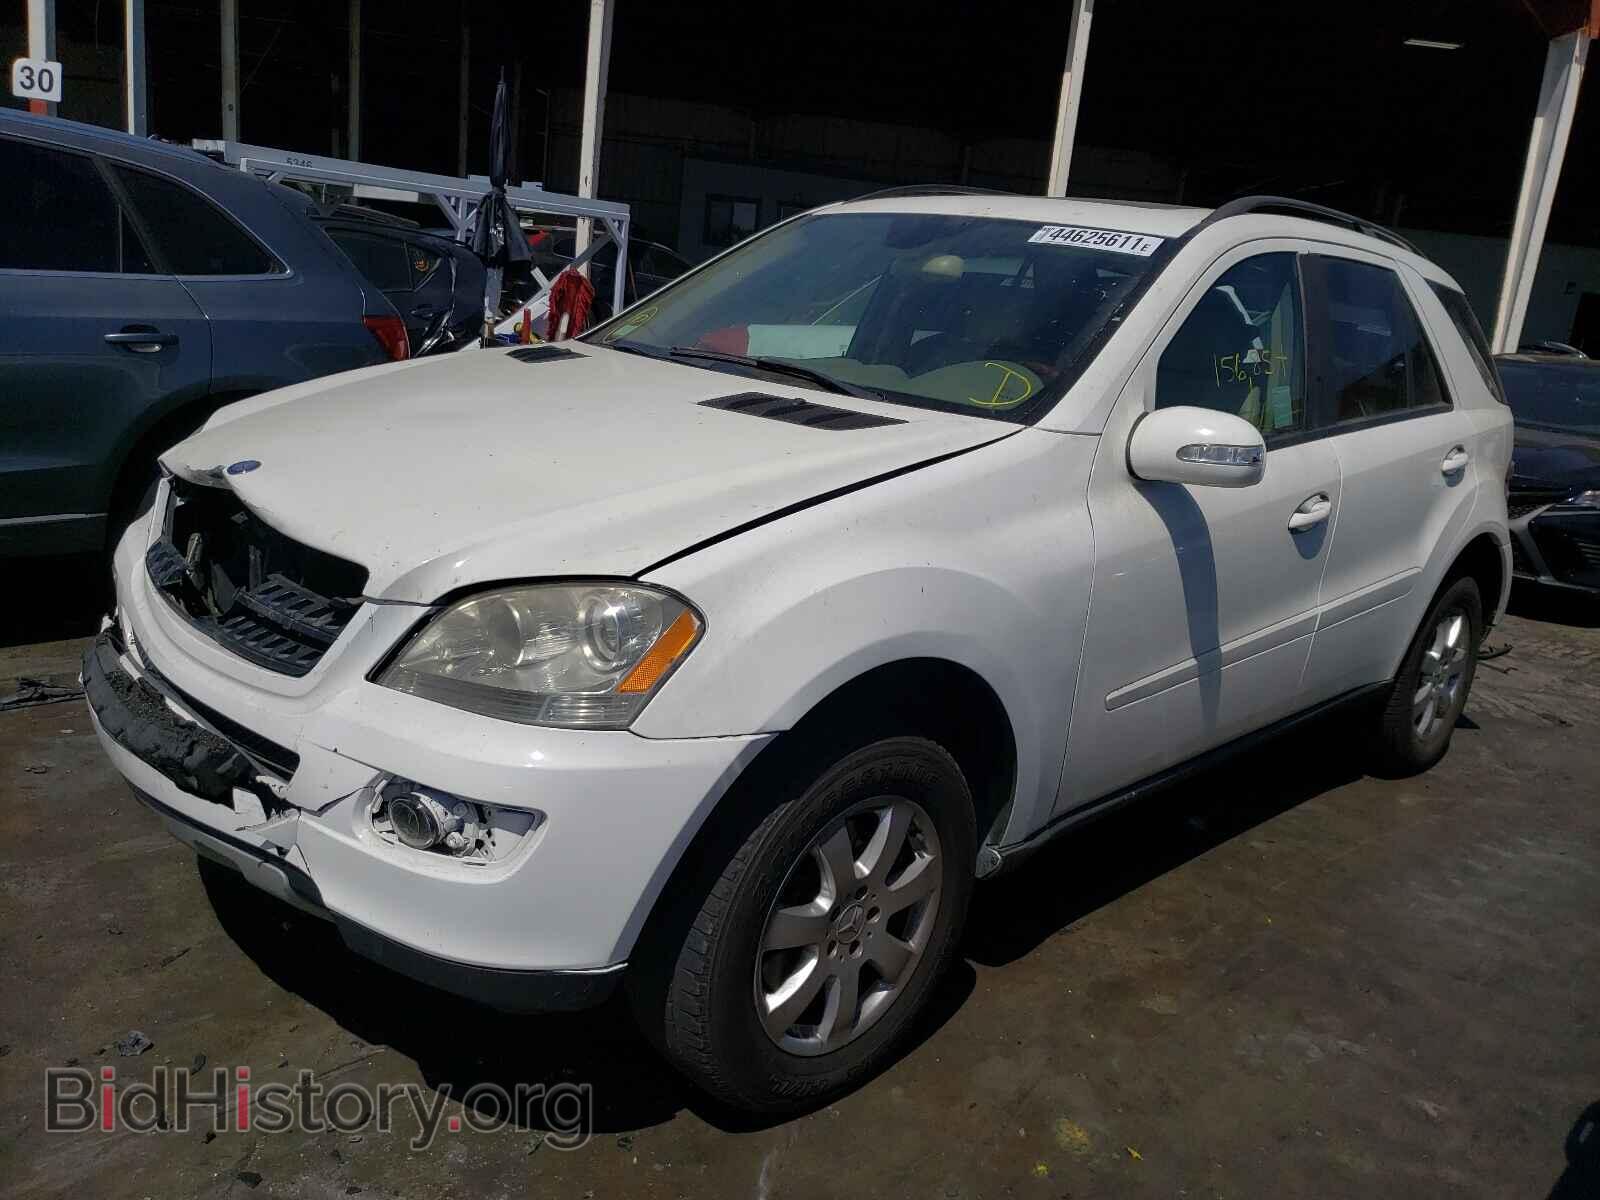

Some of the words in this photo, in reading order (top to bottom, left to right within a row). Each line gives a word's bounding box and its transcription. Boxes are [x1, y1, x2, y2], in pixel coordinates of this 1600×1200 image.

[20, 65, 54, 93] 30
[1049, 228, 1144, 251] 44625611
[968, 361, 1032, 406] D
